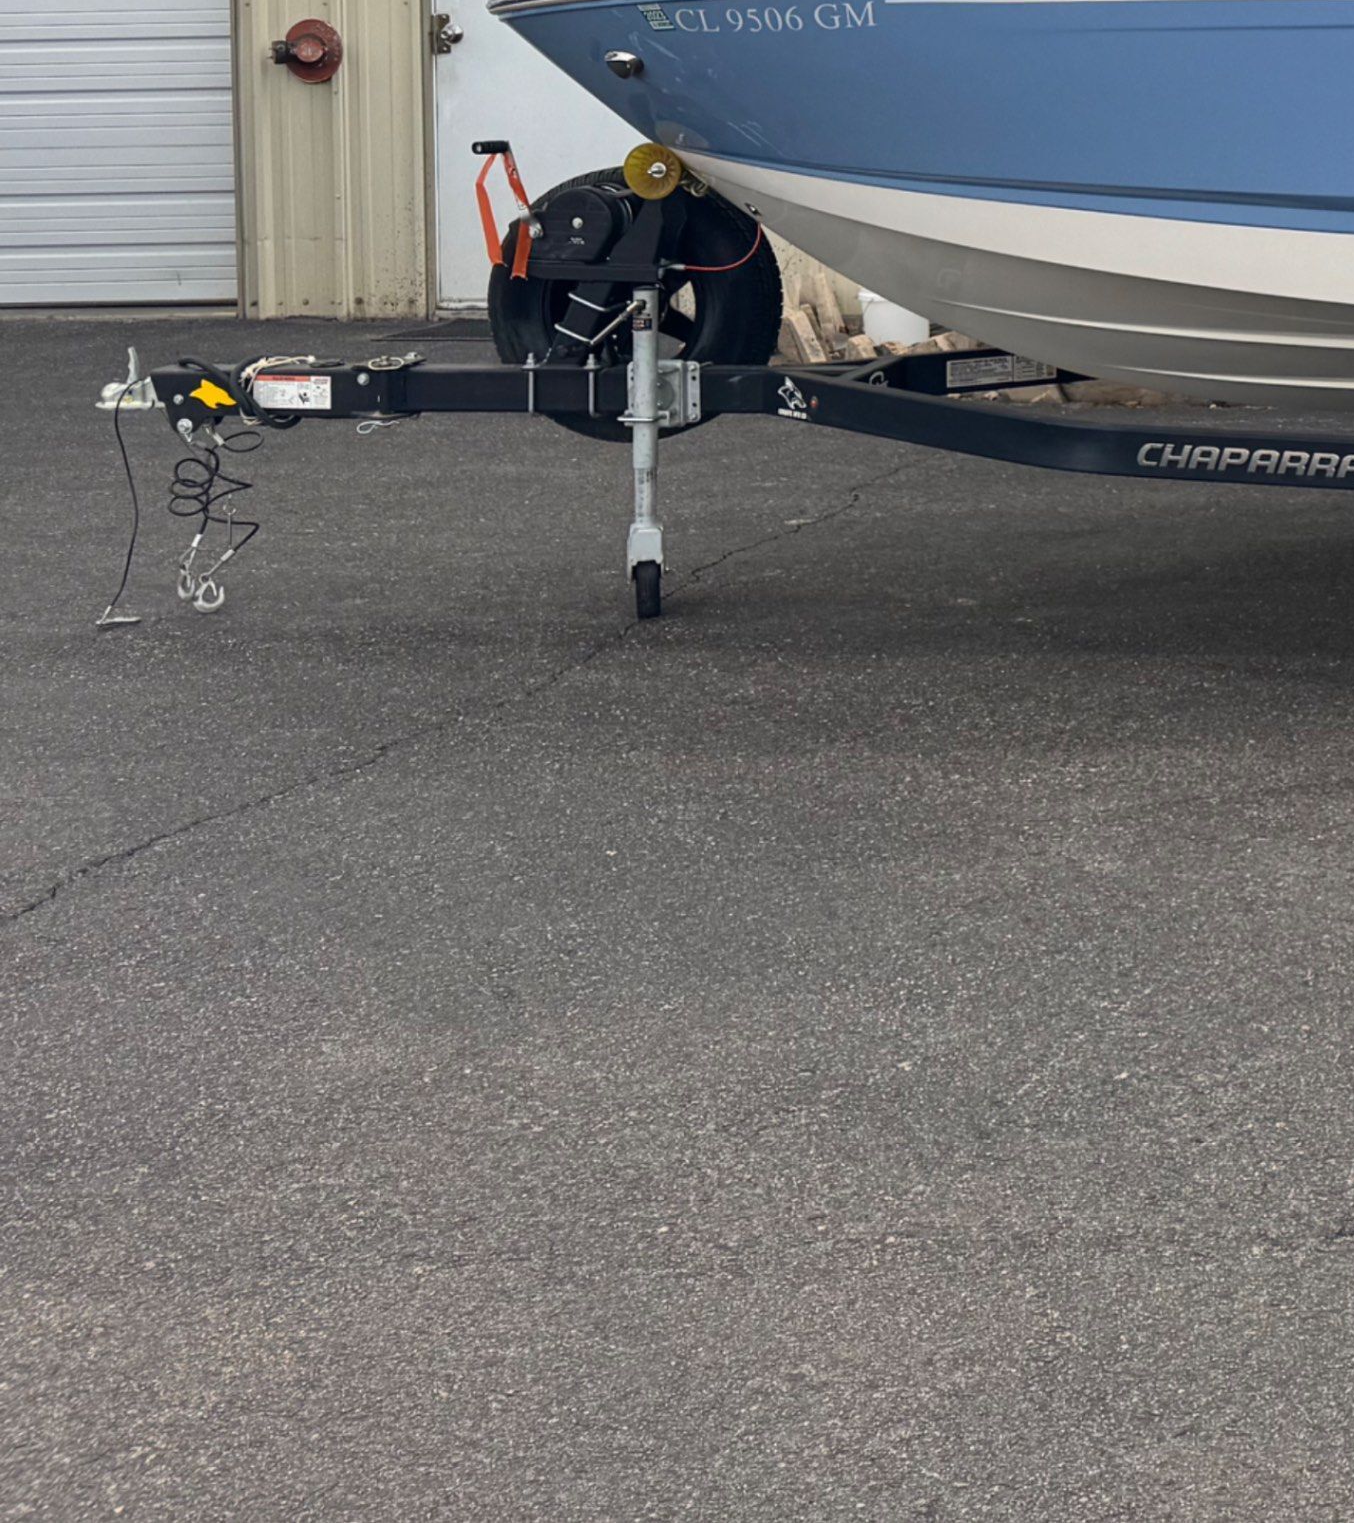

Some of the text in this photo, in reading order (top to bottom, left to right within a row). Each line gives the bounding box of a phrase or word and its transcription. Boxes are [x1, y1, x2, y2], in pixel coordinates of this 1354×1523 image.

[674, 0, 877, 33] CL 9506 GM
